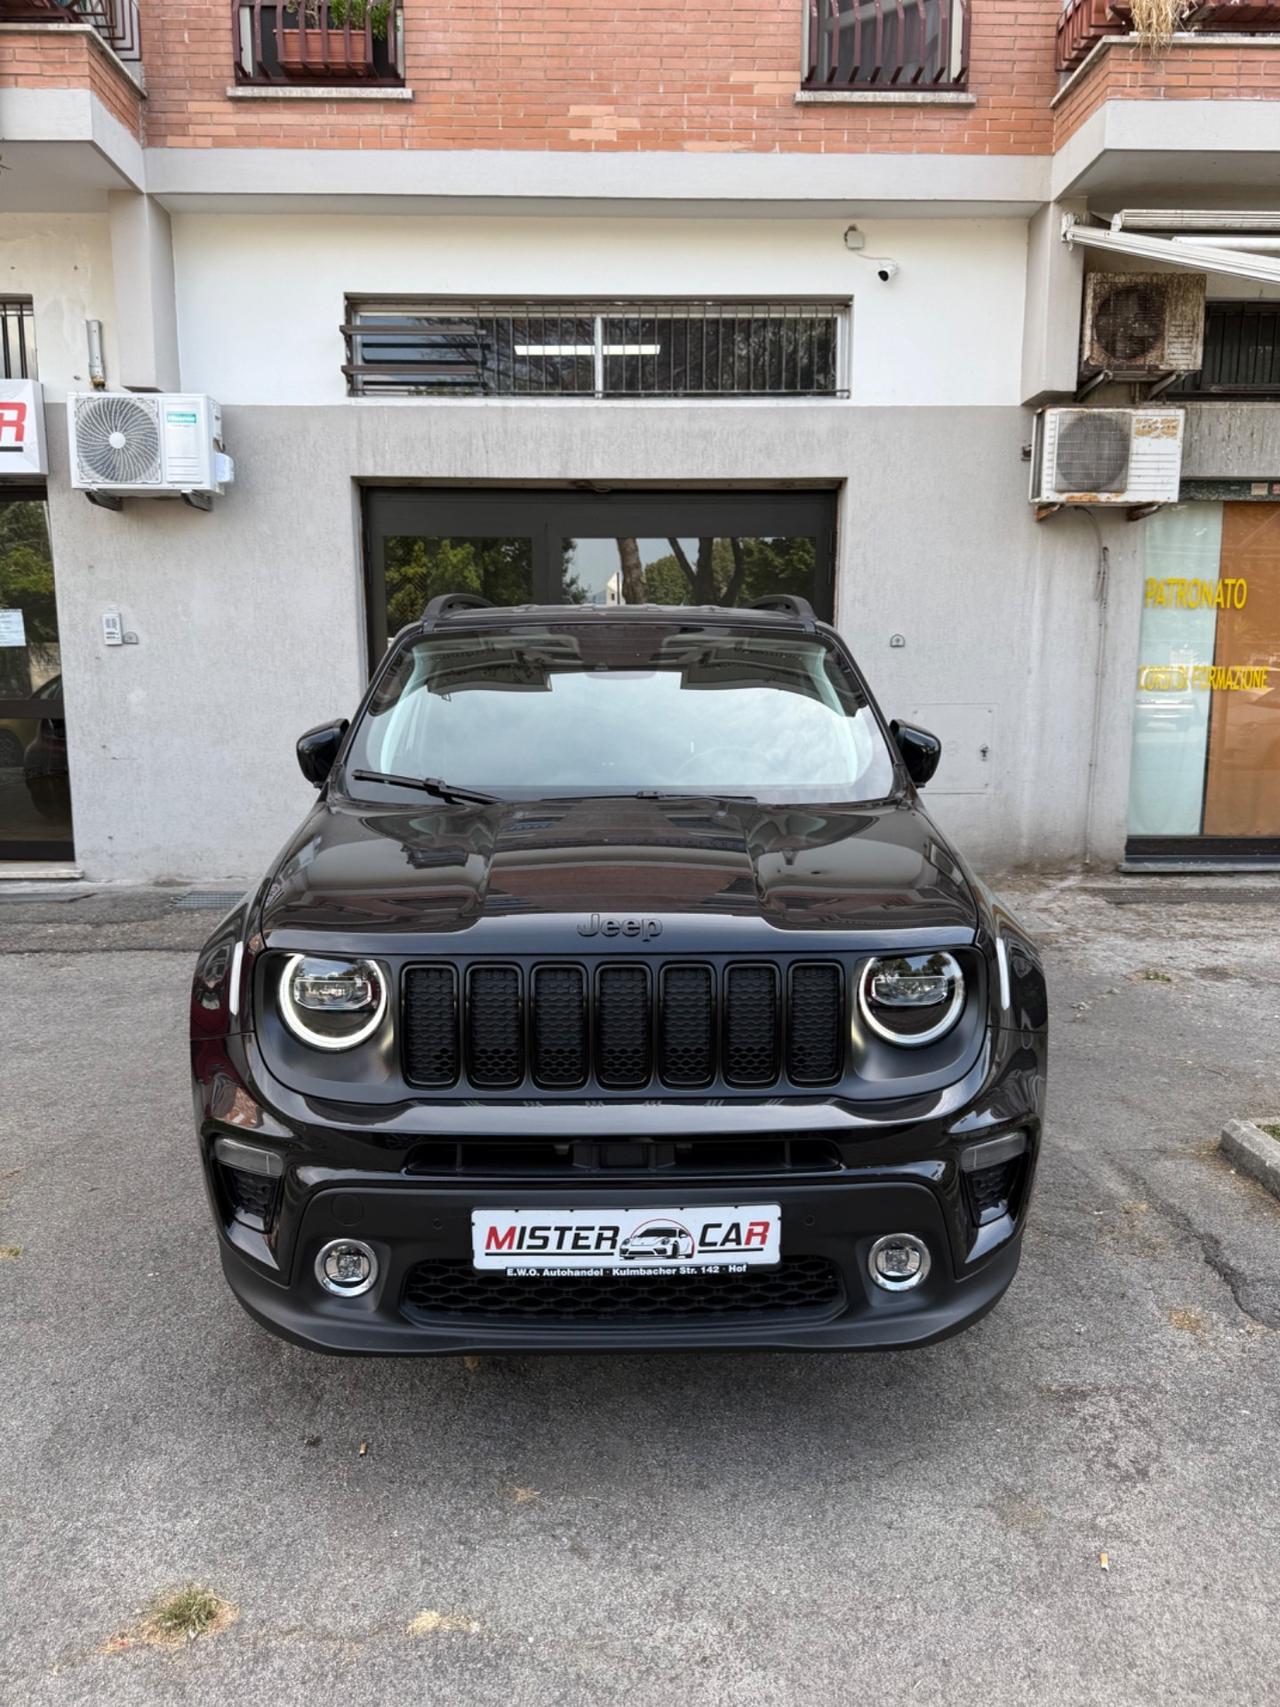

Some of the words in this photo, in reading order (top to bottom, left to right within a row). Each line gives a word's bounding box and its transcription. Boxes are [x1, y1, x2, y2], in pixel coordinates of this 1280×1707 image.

[1144, 577, 1248, 610] PATRONATO
[1192, 665, 1270, 691] FORMAZIONE
[576, 913, 663, 942] Jeep
[485, 1225, 620, 1250] MISTER
[699, 1221, 770, 1247] CAR
[506, 1268, 540, 1277] E.W.O.
[542, 1268, 604, 1277] Autohandel
[612, 1266, 677, 1276] Kulmbacher
[680, 1265, 698, 1275] Str.
[701, 1265, 720, 1274] 142
[728, 1263, 748, 1273] Hof
